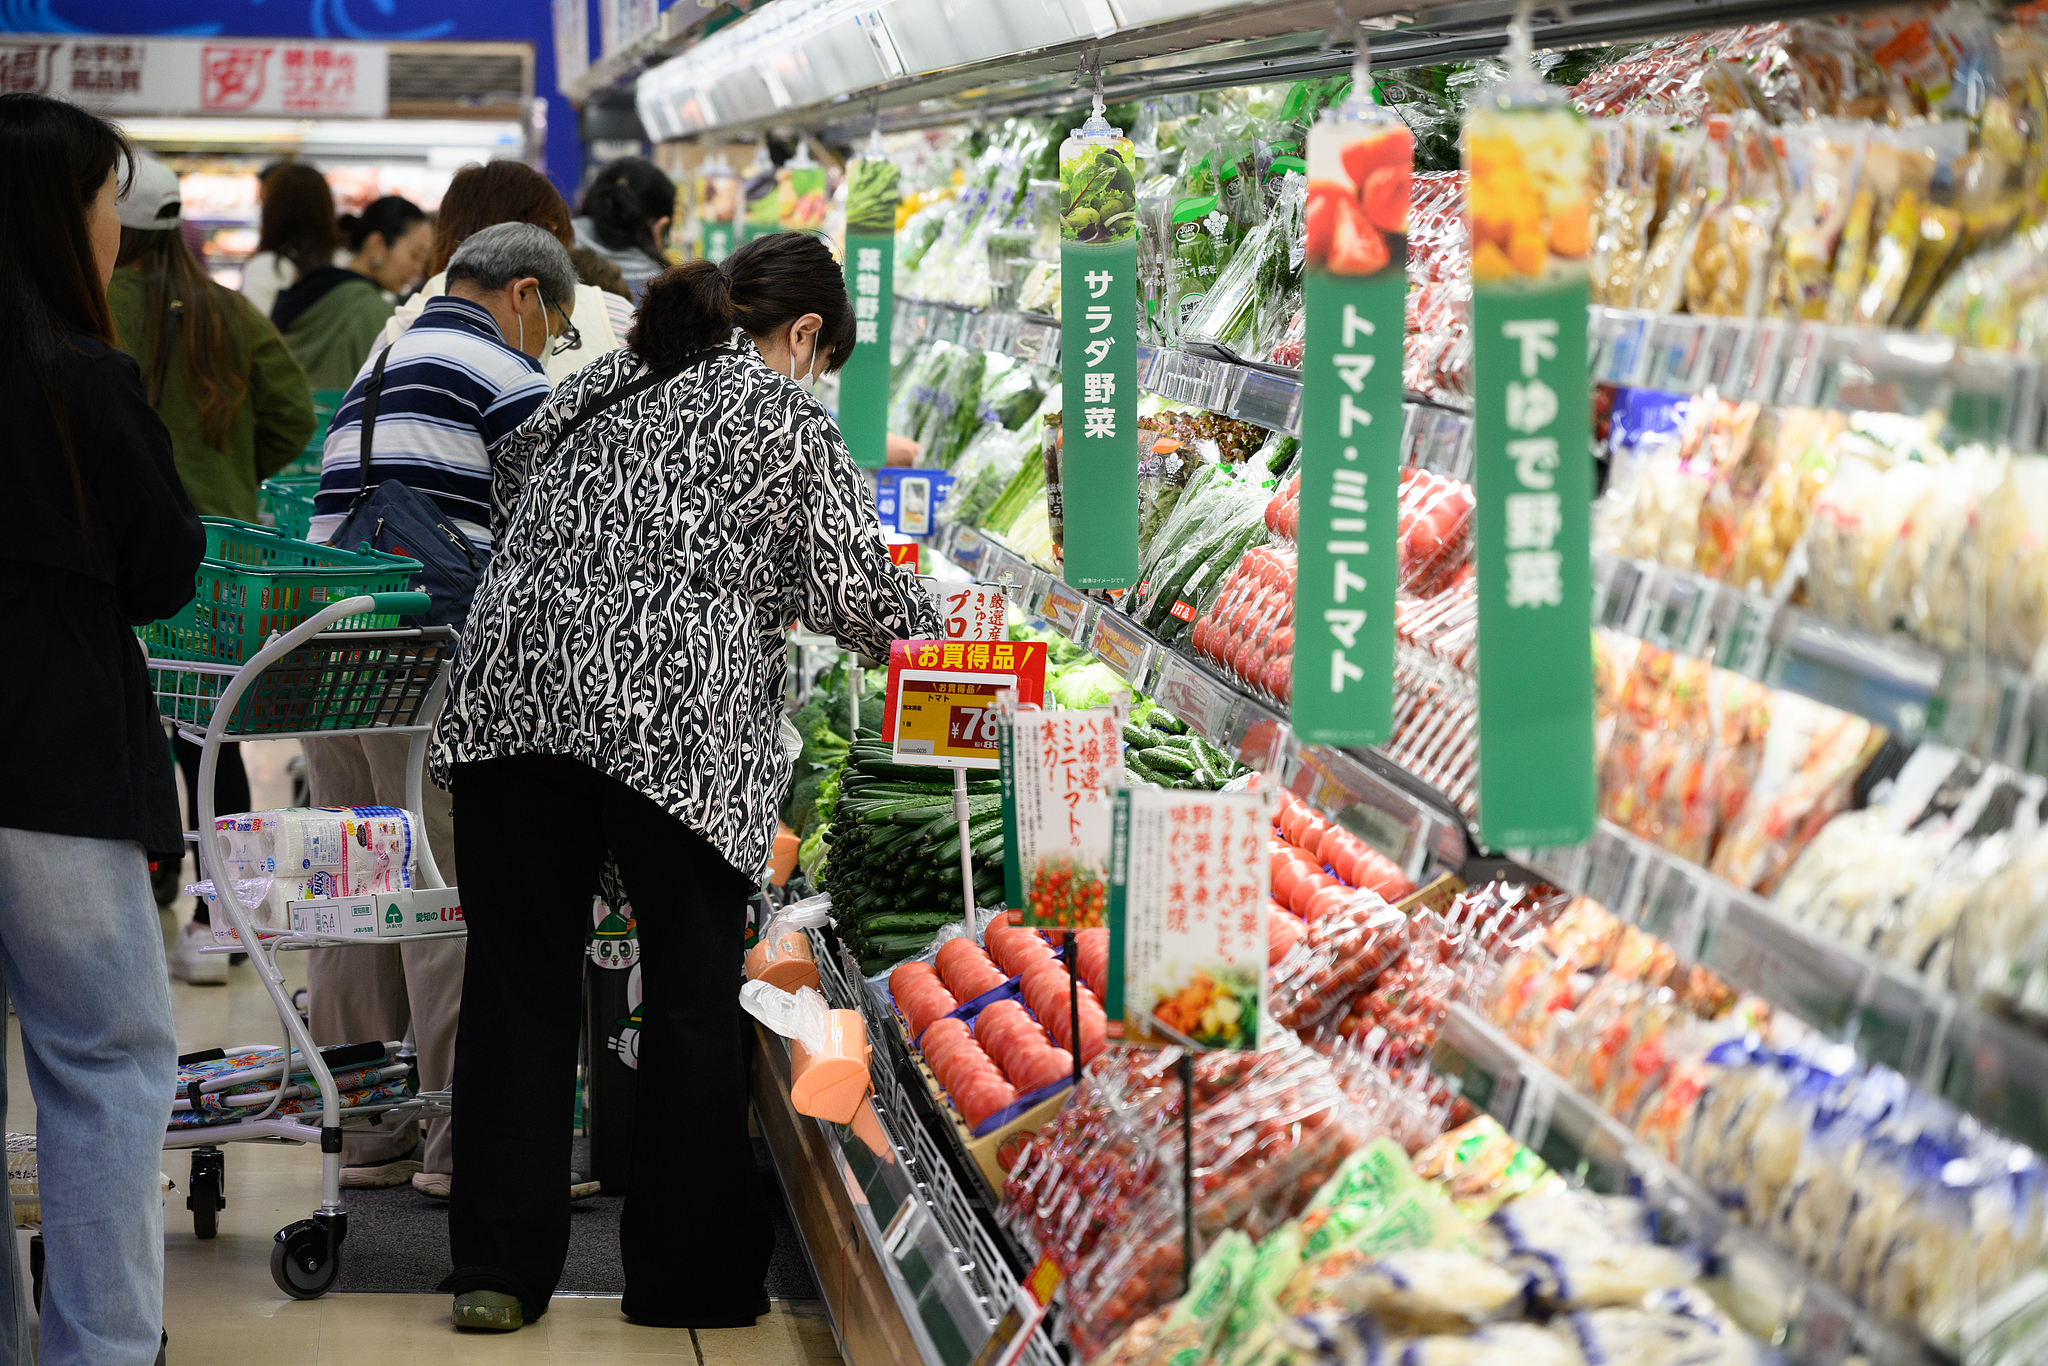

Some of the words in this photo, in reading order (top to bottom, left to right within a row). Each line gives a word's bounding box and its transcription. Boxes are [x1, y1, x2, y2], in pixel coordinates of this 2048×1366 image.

[1084, 270, 1116, 438] サラダ野菜
[1501, 319, 1564, 608] 下ゆで野菜
[1325, 304, 1376, 693] トマト・ミニトマト
[946, 589, 971, 638] プロ
[974, 592, 986, 640] きゅう
[918, 643, 1014, 670] お買得品
[928, 694, 949, 702] トマト
[938, 683, 975, 694] お買得品
[1040, 718, 1059, 792] 実力!
[1060, 718, 1081, 847] ミニトマトの
[416, 911, 438, 922] 愛知の
